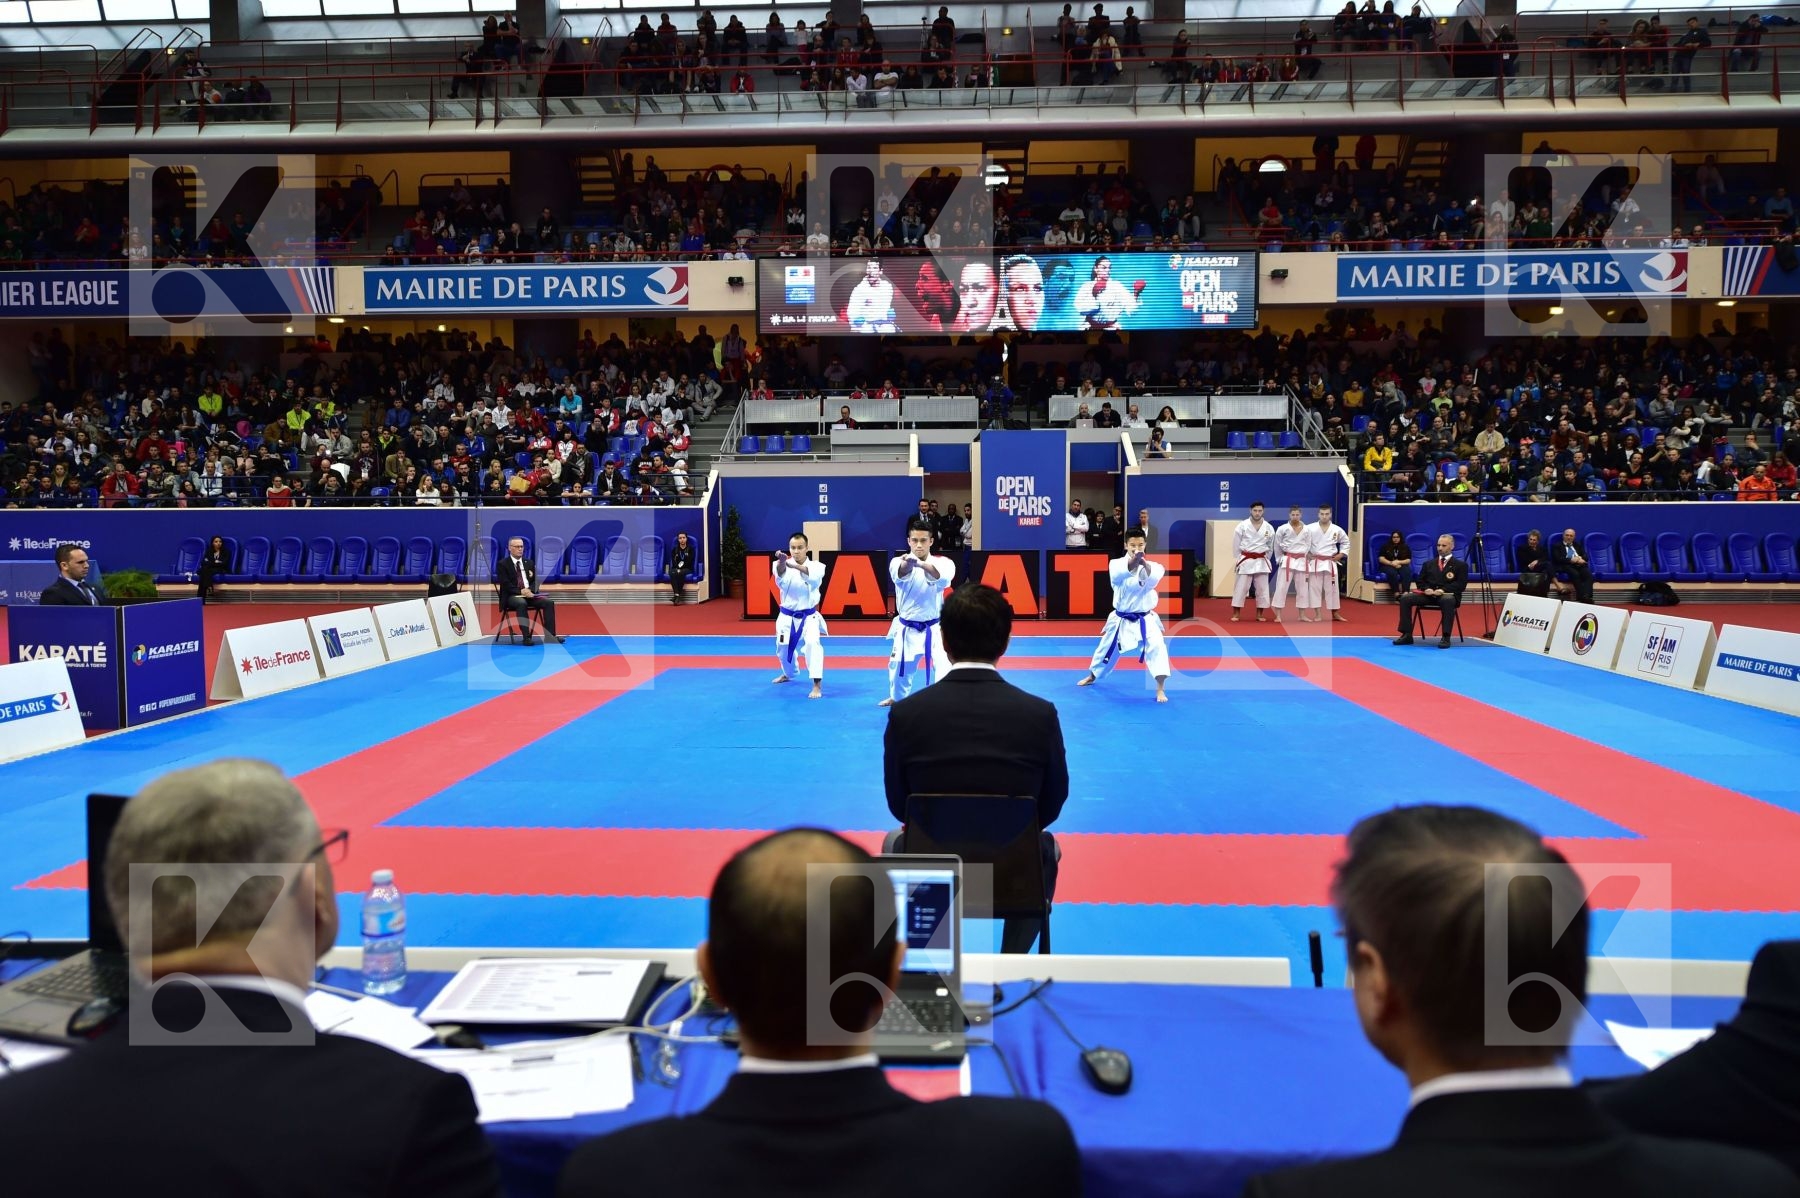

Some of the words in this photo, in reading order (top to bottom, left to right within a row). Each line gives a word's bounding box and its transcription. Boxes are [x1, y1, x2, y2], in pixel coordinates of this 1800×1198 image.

[1180, 270, 1221, 292] OPEN
[1350, 263, 1466, 288] MAIRIE
[1476, 263, 1518, 287] DE
[1530, 261, 1621, 285] PARIS
[0, 282, 35, 306] IER
[40, 281, 119, 305] LEAGUE
[376, 277, 482, 300] MAIRIE
[493, 276, 532, 298] DE
[543, 275, 626, 298] PARIS
[1193, 291, 1238, 313] PARIS
[996, 476, 1035, 496] OPEN
[998, 498, 1009, 510] DE
[1009, 496, 1052, 516] PARIS
[746, 554, 1182, 616] KAATE
[18, 641, 108, 663] KARATÉ
[1724, 656, 1754, 670] MAIRIE
[1754, 661, 1768, 673] DE
[1768, 664, 1794, 677] PARIS
[14, 700, 47, 716] PARIS
